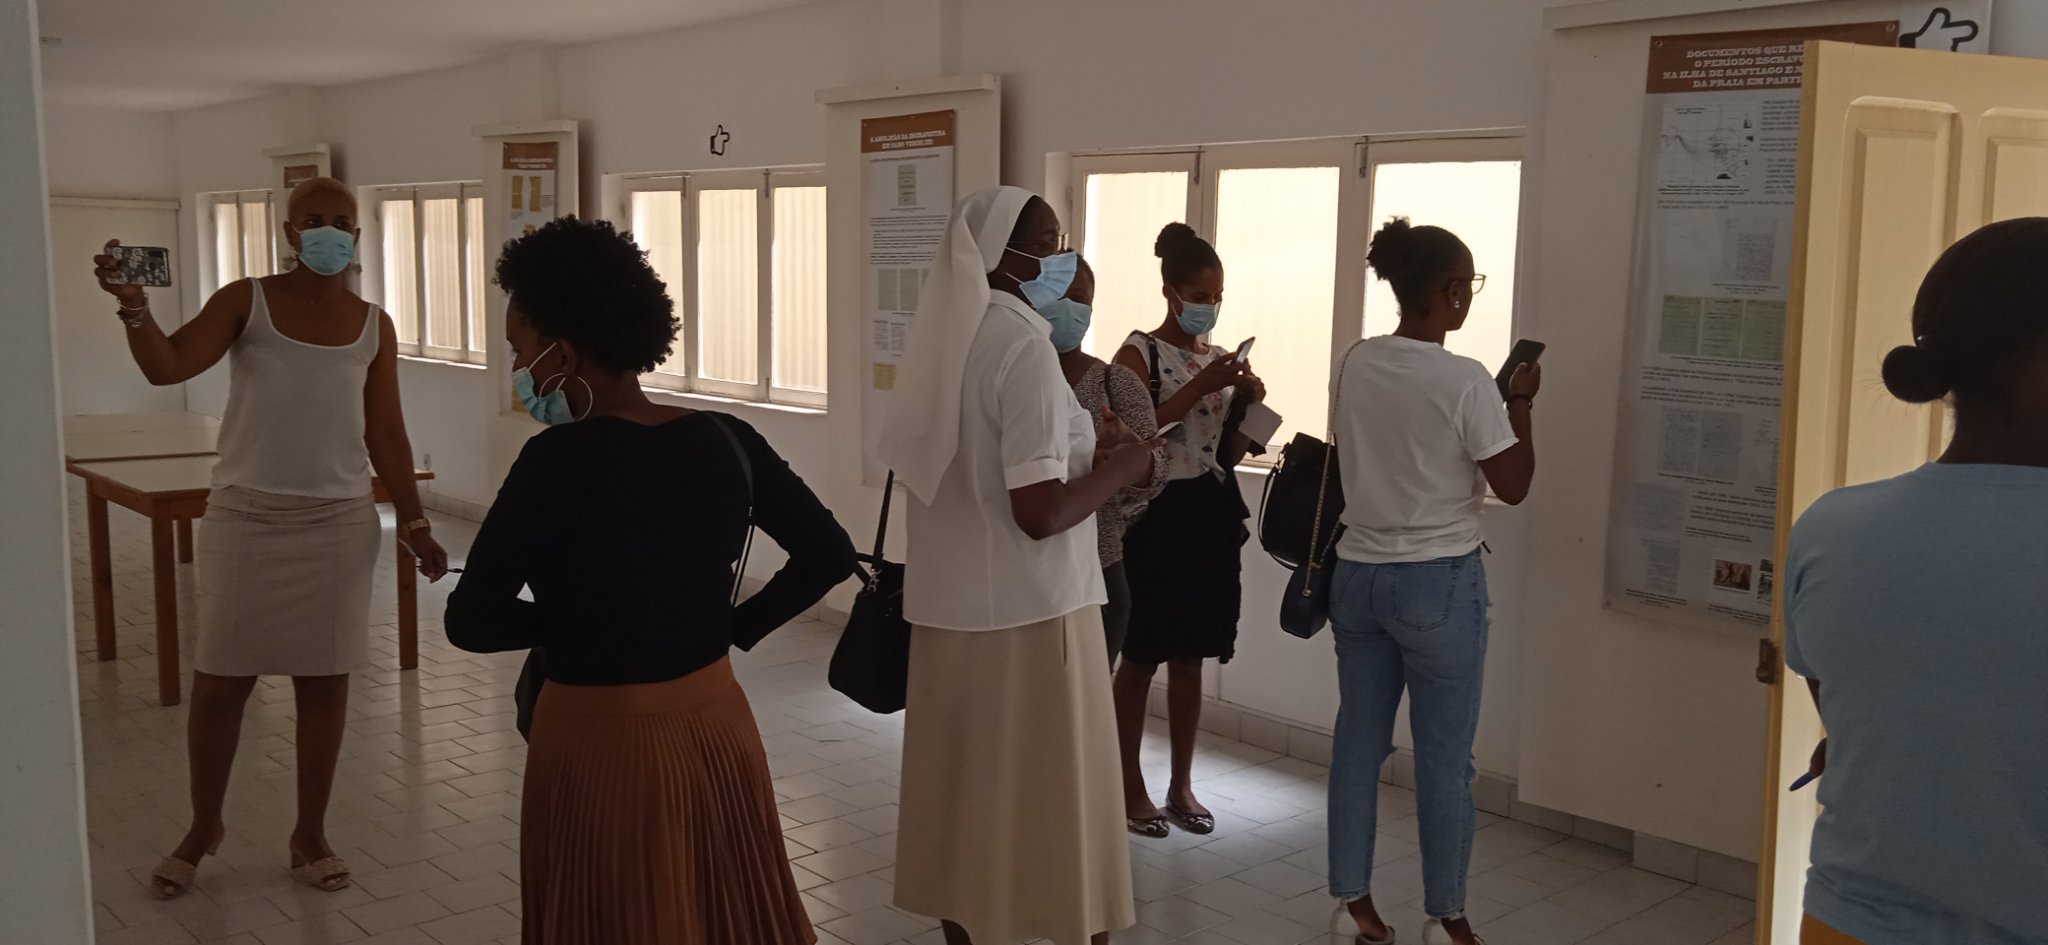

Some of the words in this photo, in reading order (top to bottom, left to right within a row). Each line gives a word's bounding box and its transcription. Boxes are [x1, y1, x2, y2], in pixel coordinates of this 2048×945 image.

[1687, 47, 1762, 58] DOCUMENTOS
[1764, 46, 1787, 54] QUE
[1704, 58, 1755, 67] PERÍODO
[1726, 67, 1783, 76] SANTIAGO
[1784, 66, 1793, 74] E
[1693, 80, 1708, 88] DA
[1710, 79, 1744, 87] PRAIA
